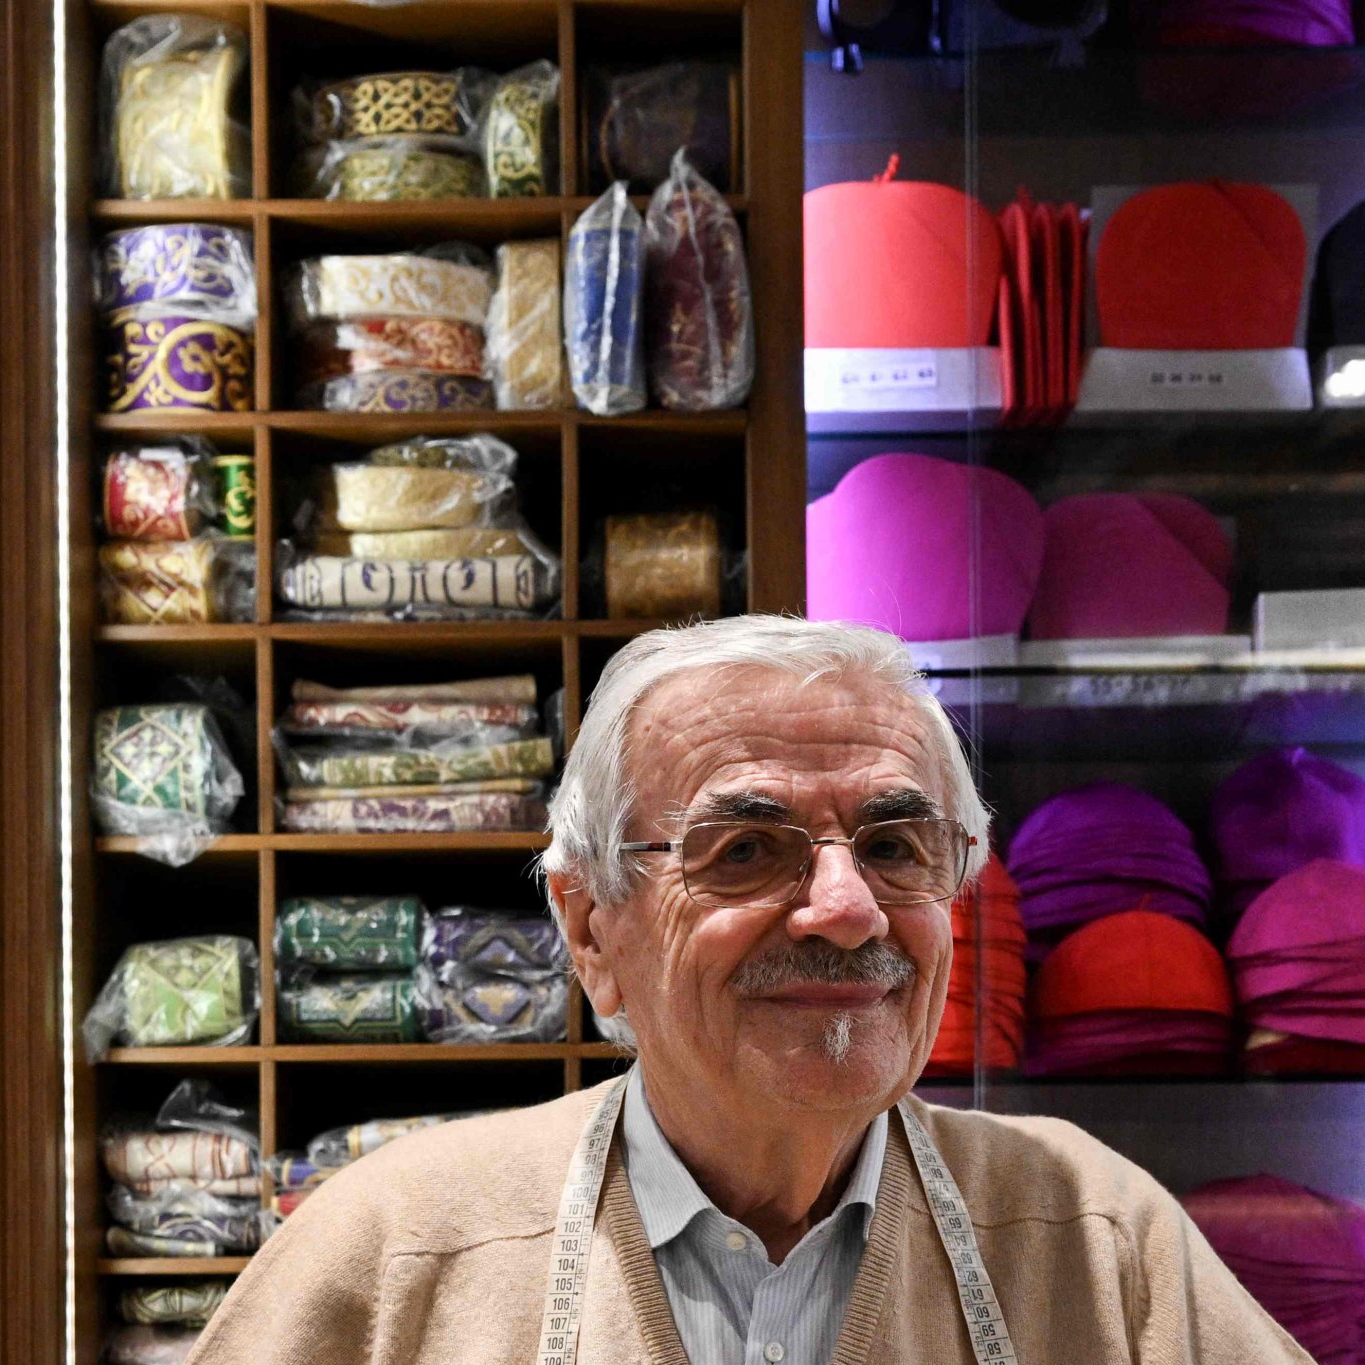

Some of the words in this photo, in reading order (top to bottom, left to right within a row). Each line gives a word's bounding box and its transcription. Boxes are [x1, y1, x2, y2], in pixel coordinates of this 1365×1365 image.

[595, 1123, 604, 1133] 96
[589, 1139, 600, 1149] 97
[568, 1203, 585, 1215] 101
[943, 1201, 956, 1211] 66
[564, 1222, 582, 1233] 102
[948, 1217, 962, 1228] 65
[561, 1240, 578, 1251] 103
[558, 1259, 575, 1270] 104
[965, 1271, 979, 1282] 62
[555, 1278, 573, 1290] 105
[972, 1289, 984, 1300] 61
[553, 1298, 570, 1310] 106
[977, 1306, 989, 1318] 60
[550, 1318, 567, 1330] 107
[982, 1324, 996, 1337] 59
[547, 1337, 564, 1349] 108
[987, 1342, 1001, 1355] 58
